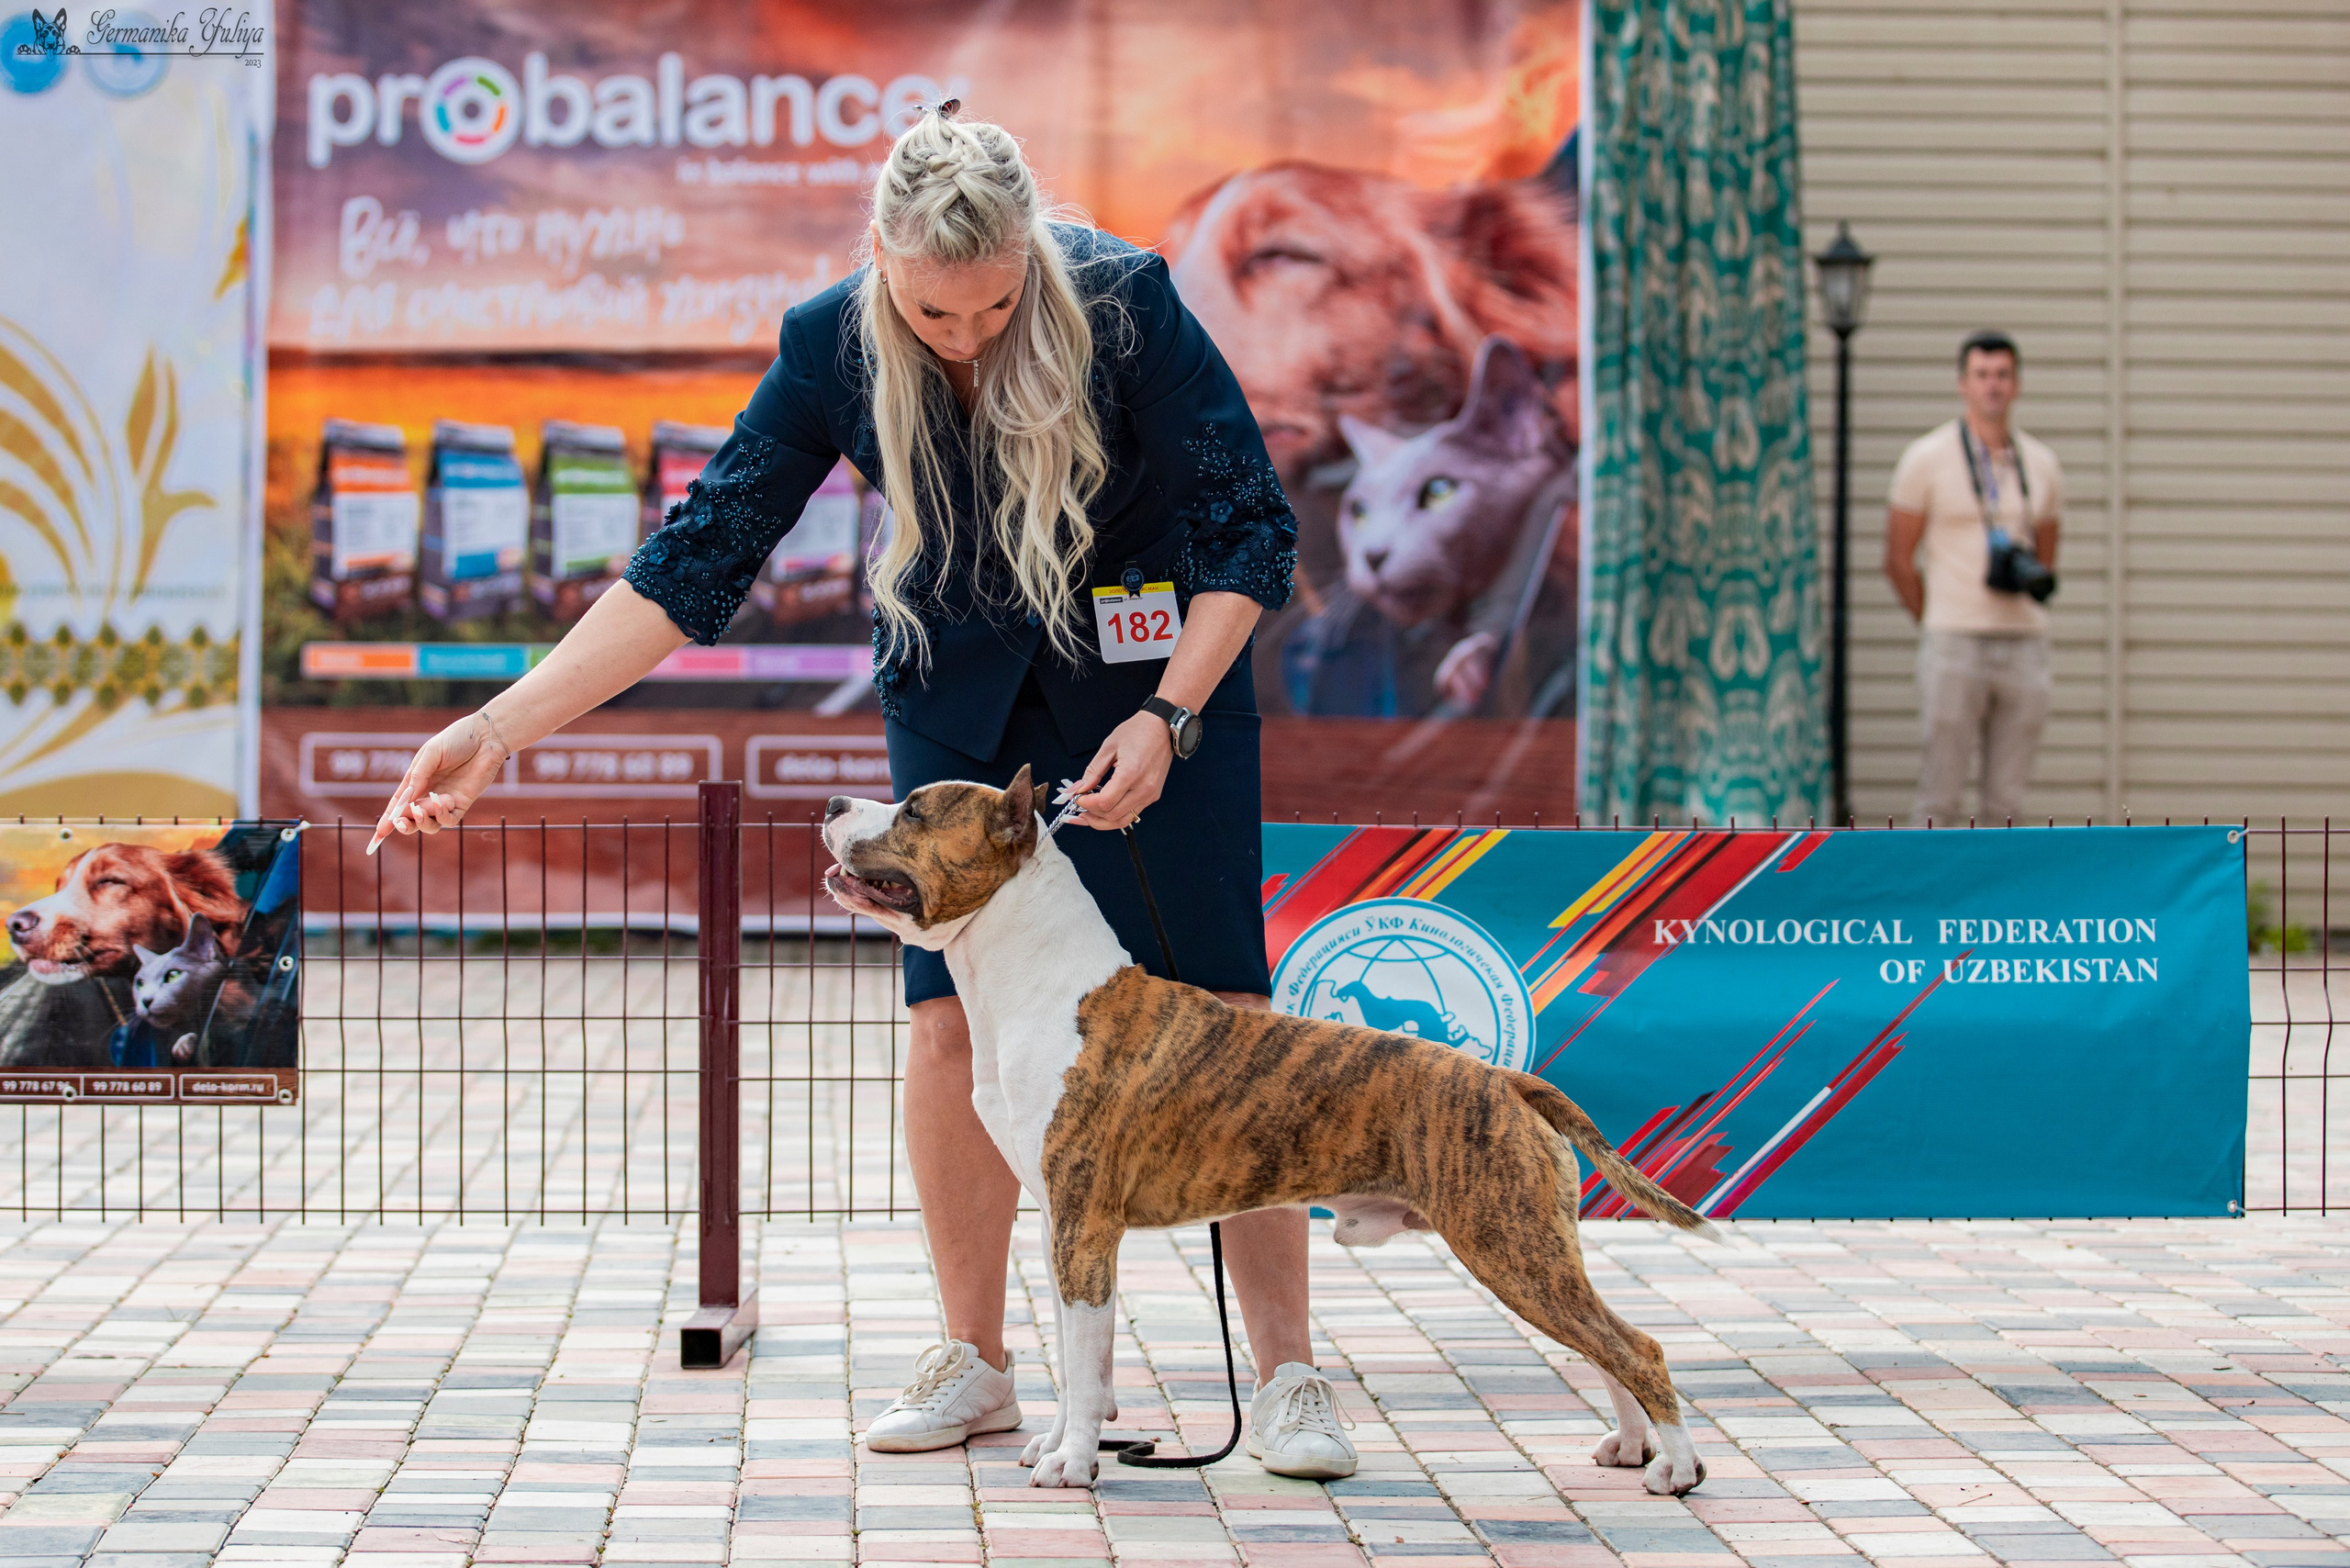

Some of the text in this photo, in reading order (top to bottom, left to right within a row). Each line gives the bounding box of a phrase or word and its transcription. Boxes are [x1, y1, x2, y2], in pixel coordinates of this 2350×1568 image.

[1107, 610, 1173, 644] 182
[1652, 918, 2157, 946] KYNOLOGICAL FEDERATION
[1879, 958, 2159, 983] OF UZBEKISTAN
[1501, 993, 1517, 1068] Федераци
[2, 1081, 17, 1092] 99
[18, 1081, 39, 1092] 778
[40, 1081, 55, 1092] 67
[93, 1081, 162, 1092] 99 778 60 89
[192, 1081, 264, 1092] delo-korm.ru
